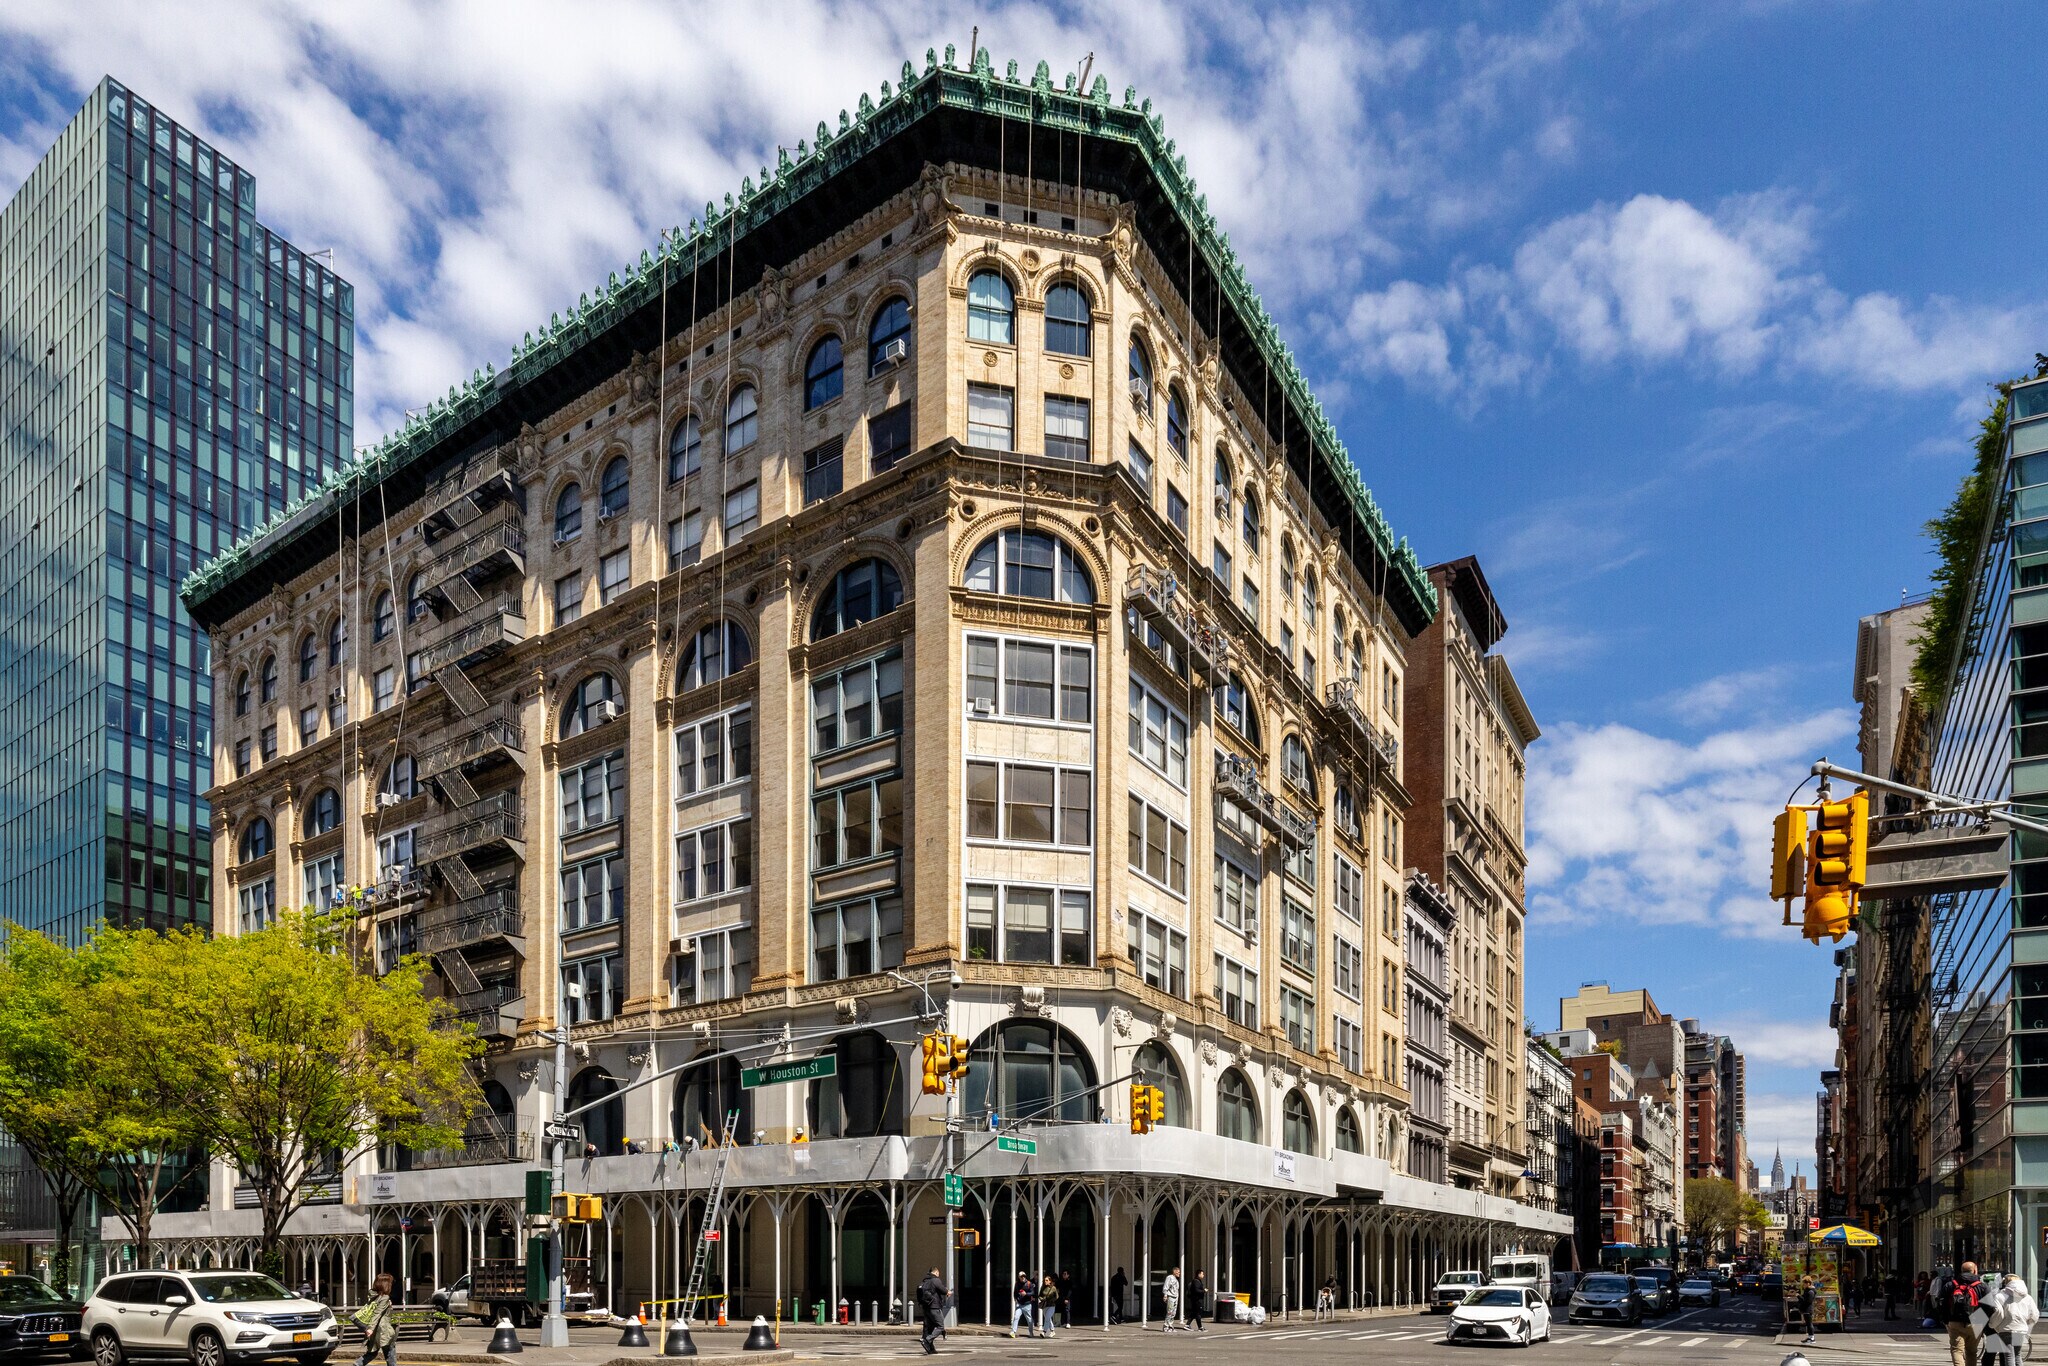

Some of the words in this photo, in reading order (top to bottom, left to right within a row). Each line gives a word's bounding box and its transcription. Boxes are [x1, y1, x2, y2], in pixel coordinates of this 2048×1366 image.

[758, 1070, 767, 1082] W
[770, 1066, 807, 1080] Houston
[809, 1062, 819, 1074] St
[550, 1126, 562, 1136] ONE
[1007, 1140, 1029, 1153] Broadway
